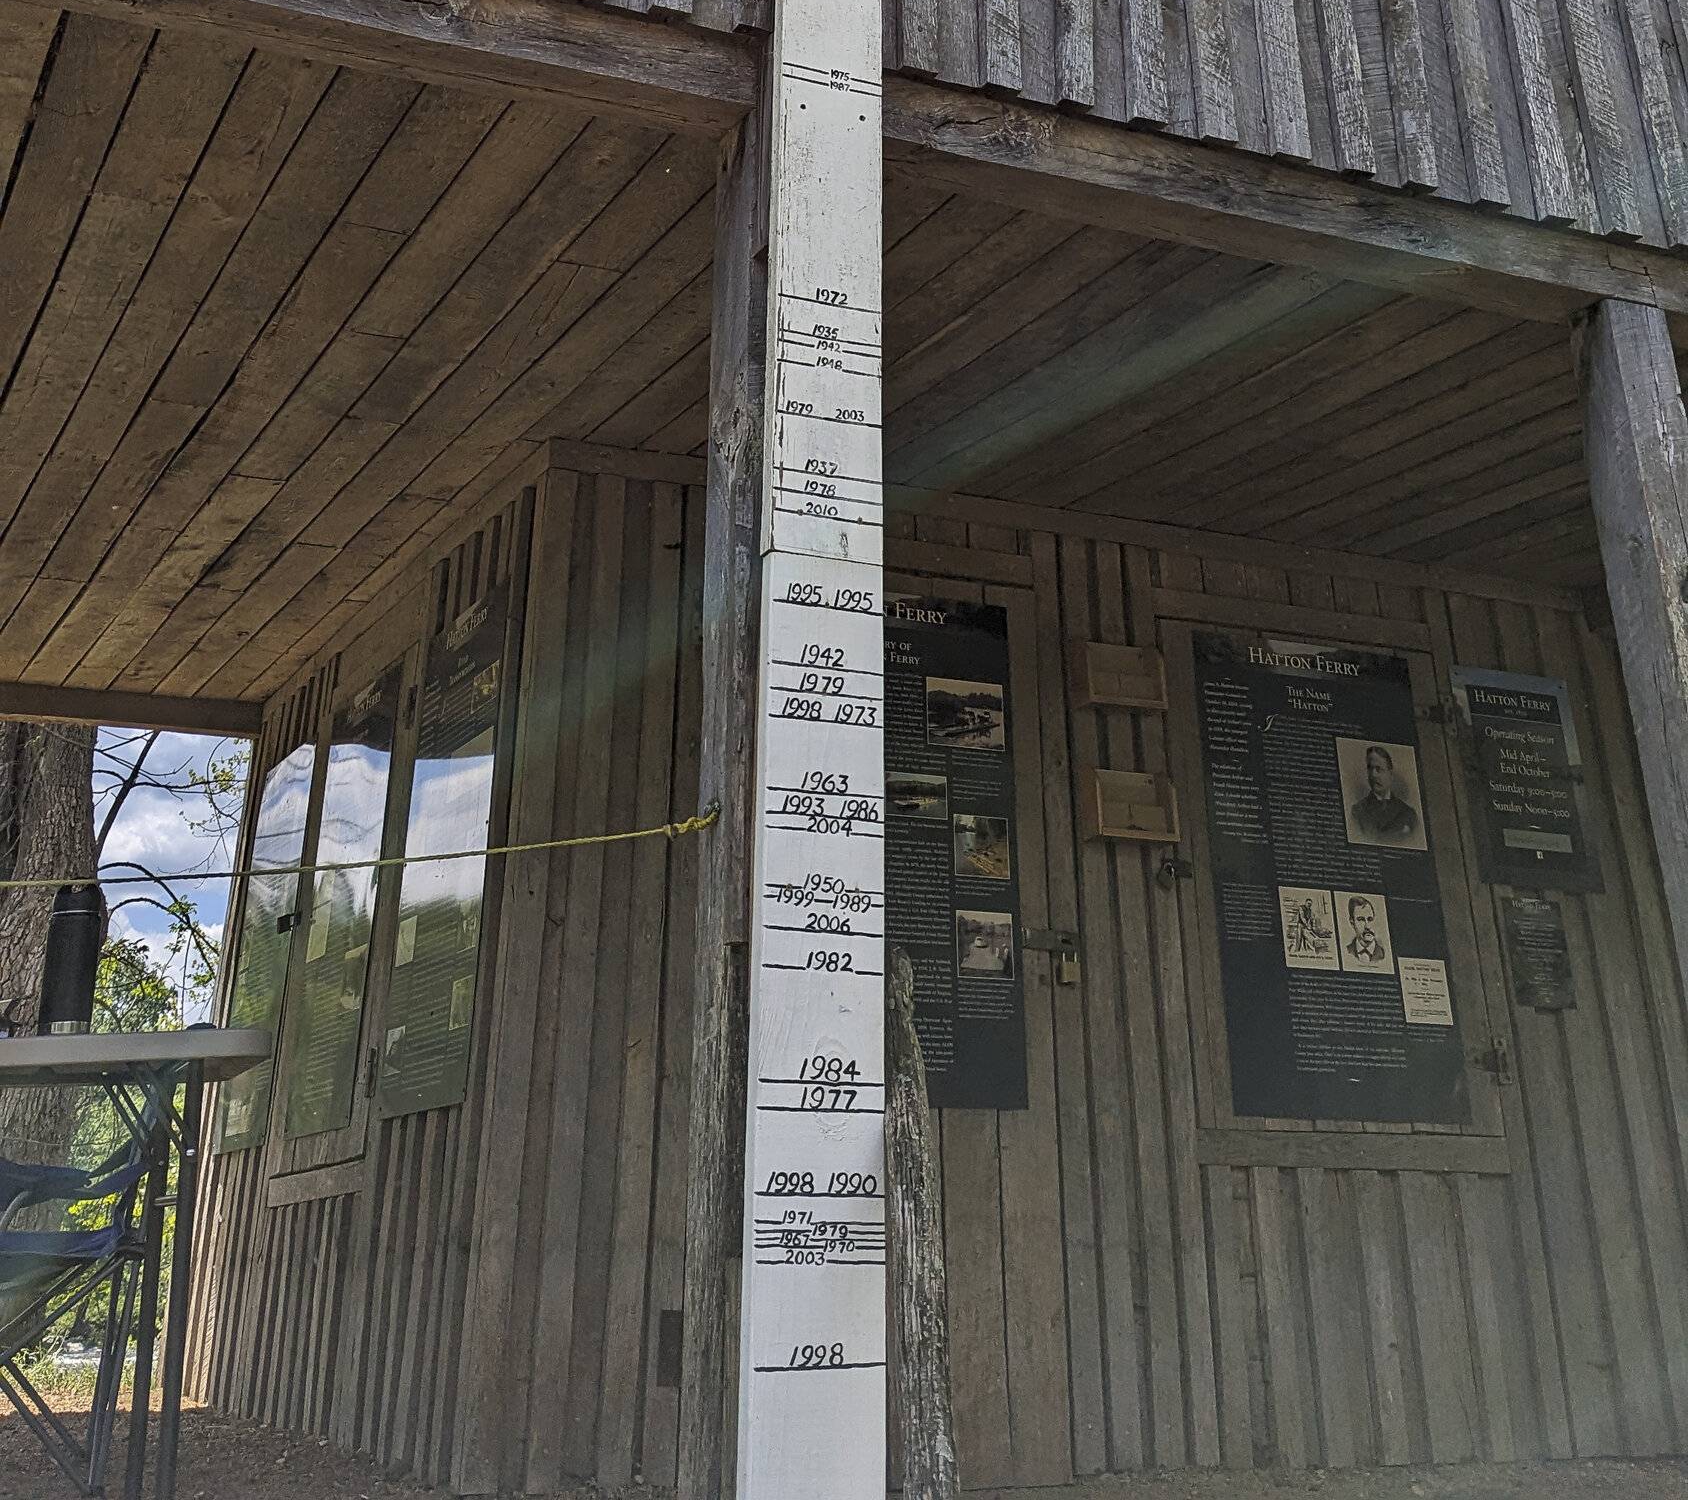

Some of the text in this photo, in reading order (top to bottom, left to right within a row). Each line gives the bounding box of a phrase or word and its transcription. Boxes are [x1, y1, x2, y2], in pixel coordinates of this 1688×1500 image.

[830, 68, 850, 82] 1975
[815, 287, 848, 305] 1972
[812, 324, 839, 339] 1935
[816, 340, 841, 354] 1942
[785, 400, 865, 422] 1979 2003
[804, 458, 838, 475] 1937
[803, 479, 837, 497] 1978
[805, 502, 838, 516] 2010
[786, 583, 874, 611] 1995 1995
[895, 602, 947, 625] FERRY
[800, 643, 845, 668] 1942
[899, 642, 912, 651] OF
[890, 651, 920, 665] FERRY
[1248, 646, 1360, 677] HATTON FERRY
[800, 672, 845, 694] 1979
[1474, 689, 1551, 712] HATTON FERRY
[782, 697, 878, 726] 1998 1973
[801, 771, 849, 794] 1963
[1489, 780, 1525, 796] Saturday
[782, 794, 879, 821] 1993 1986
[1493, 800, 1523, 815] Sunday
[807, 817, 852, 837] 2004
[803, 873, 845, 894] 1950
[776, 888, 871, 913] 1999 1989
[805, 913, 851, 933] 2006
[806, 951, 853, 973] 1982
[799, 1055, 860, 1082] 1984
[800, 1086, 858, 1110] 1977
[766, 1171, 877, 1194] 1998 1990
[782, 1210, 813, 1225] 1971
[779, 1231, 810, 1246] 1967
[812, 1224, 848, 1238] 1979
[823, 1240, 855, 1253] 1970
[784, 1249, 825, 1266] 2003
[789, 1343, 843, 1367] 1998
